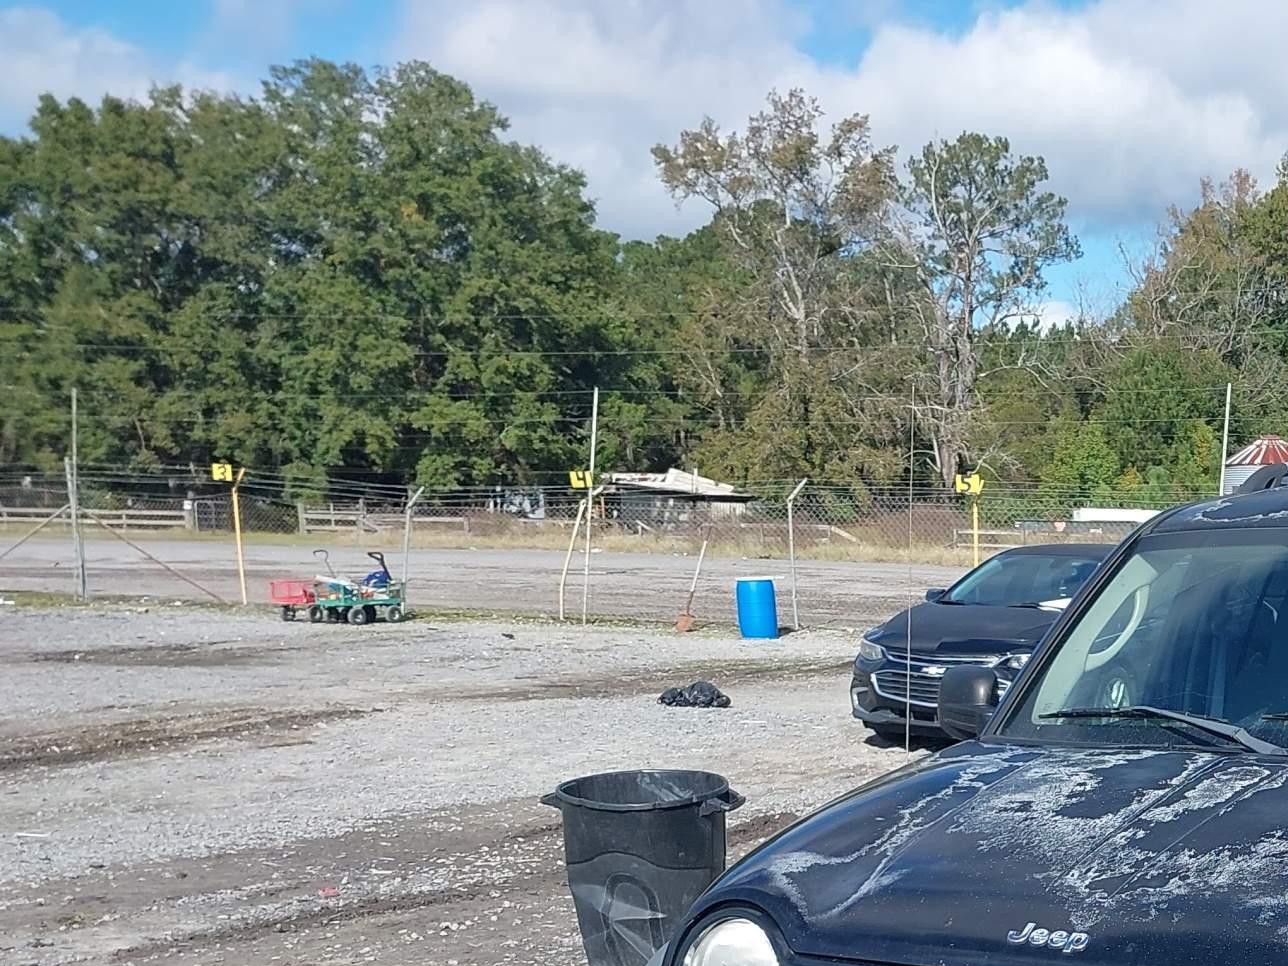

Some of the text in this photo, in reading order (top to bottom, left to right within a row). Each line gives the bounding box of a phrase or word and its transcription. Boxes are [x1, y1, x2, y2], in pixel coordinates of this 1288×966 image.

[217, 464, 227, 481] 3
[575, 471, 588, 489] 4
[959, 474, 972, 492] 5
[1007, 922, 1090, 954] Jeep
